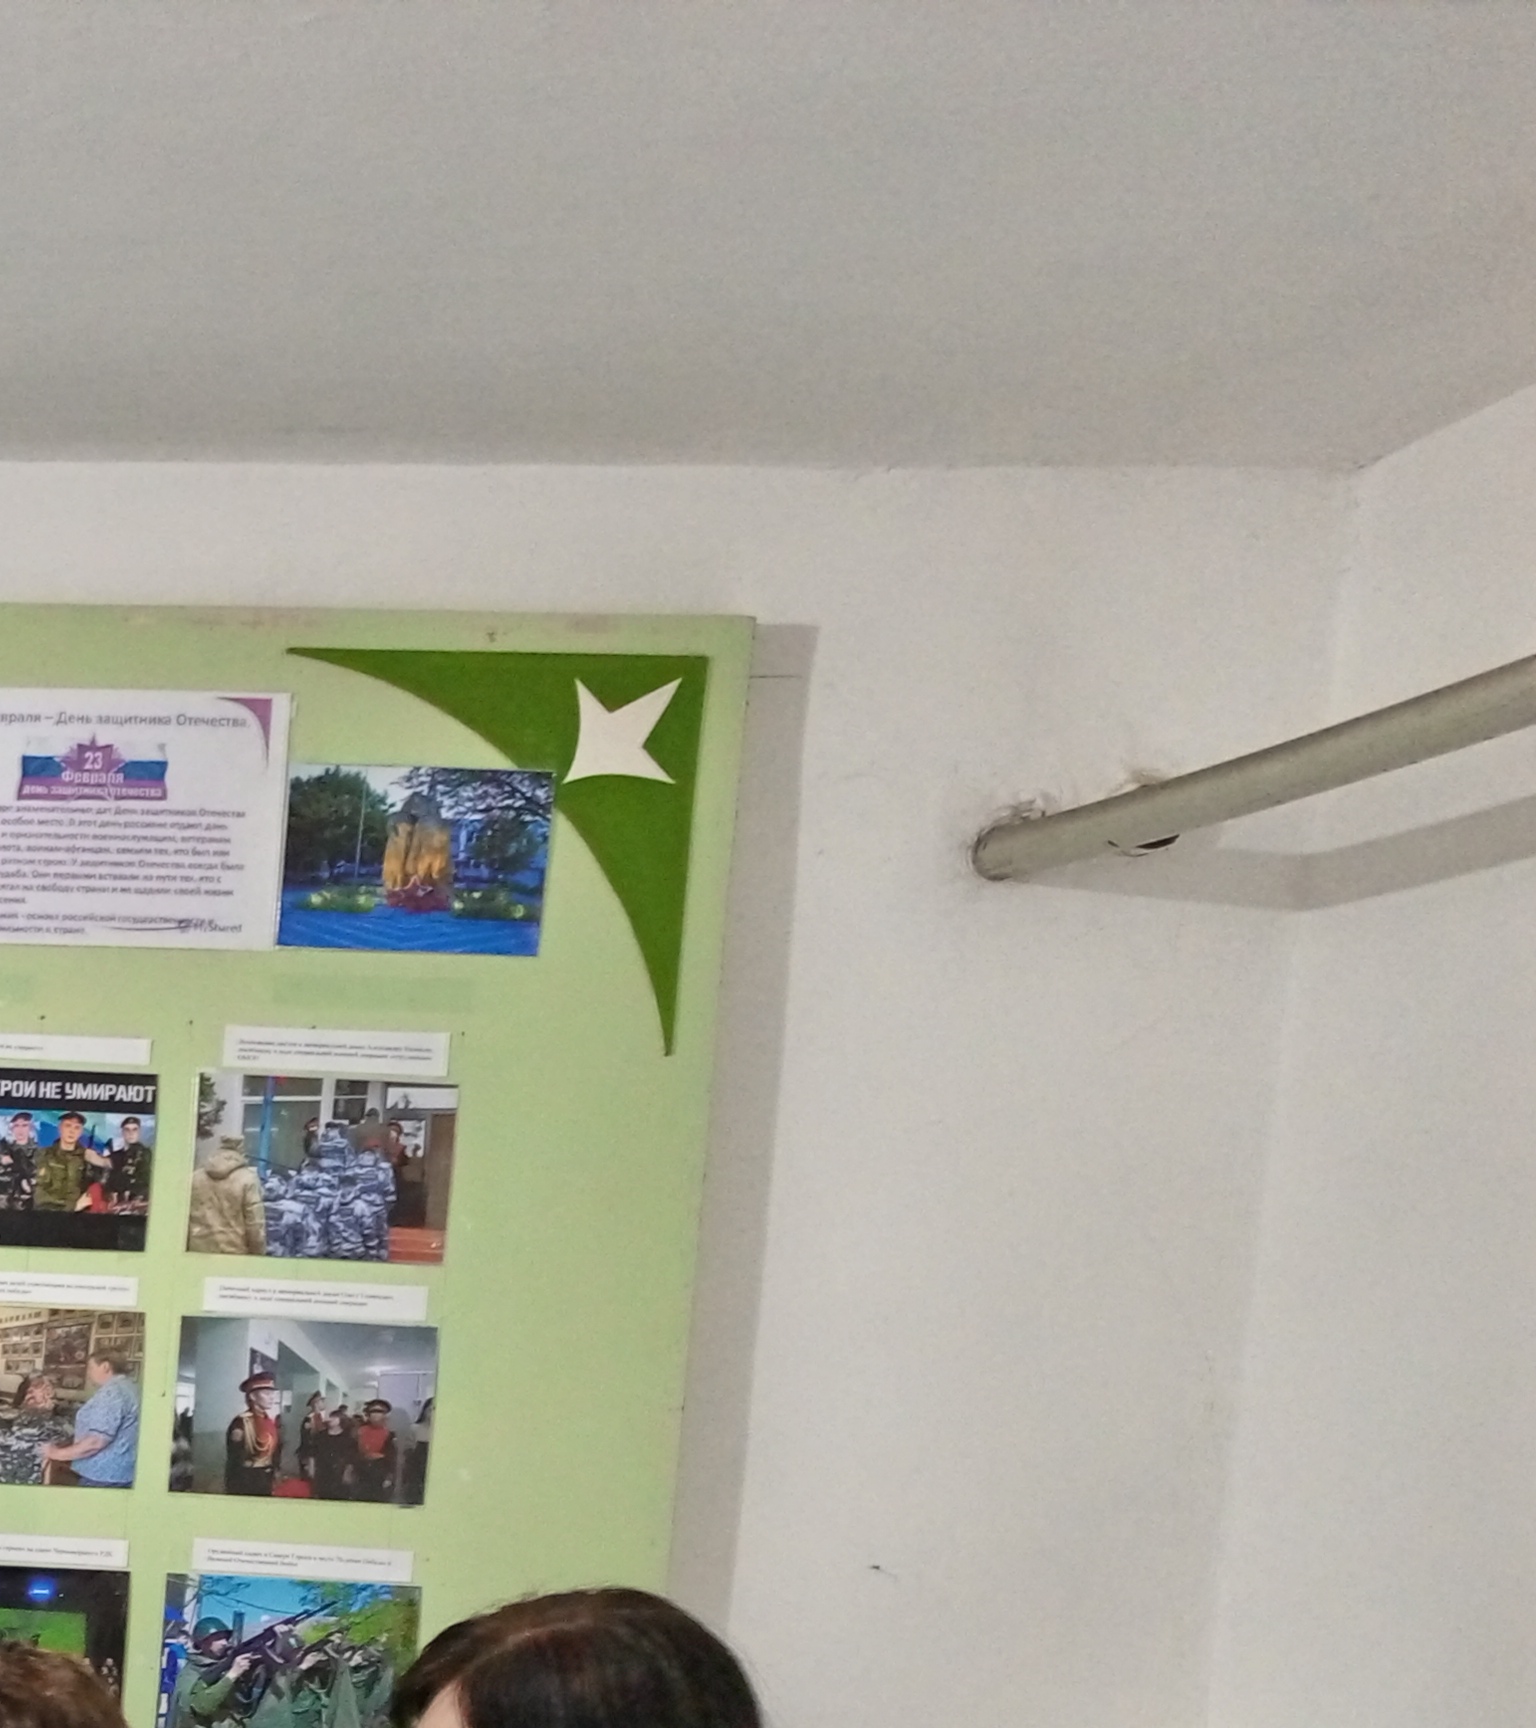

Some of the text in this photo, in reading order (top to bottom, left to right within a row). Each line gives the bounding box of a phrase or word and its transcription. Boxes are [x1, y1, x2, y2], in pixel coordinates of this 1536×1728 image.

[55, 713, 93, 727] День
[96, 715, 172, 728] защитника
[84, 752, 103, 770] 23
[61, 770, 124, 785] Февраля
[38, 1081, 62, 1099] НЕ
[64, 1082, 156, 1103] УМИРАЮТ
